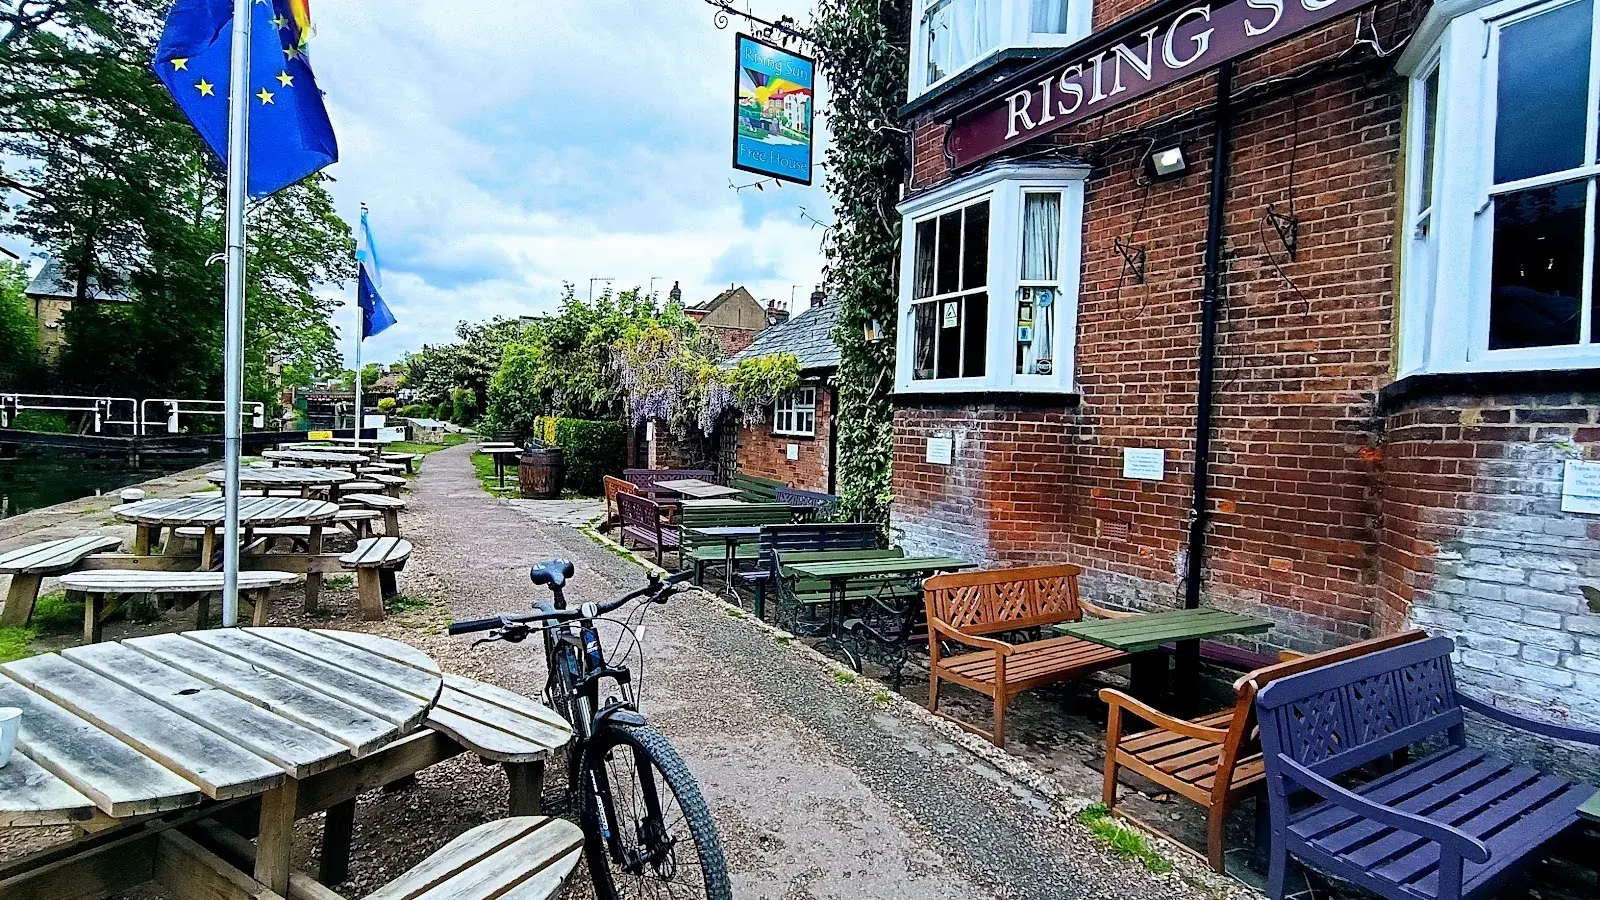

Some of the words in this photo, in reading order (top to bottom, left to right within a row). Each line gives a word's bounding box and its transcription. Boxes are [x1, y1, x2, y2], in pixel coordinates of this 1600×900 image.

[745, 46, 783, 75] Rising
[786, 61, 808, 81] Sun
[1004, 5, 1215, 140] RISING
[1244, 0, 1337, 36] S
[740, 143, 766, 162] Free
[769, 151, 808, 173] House
